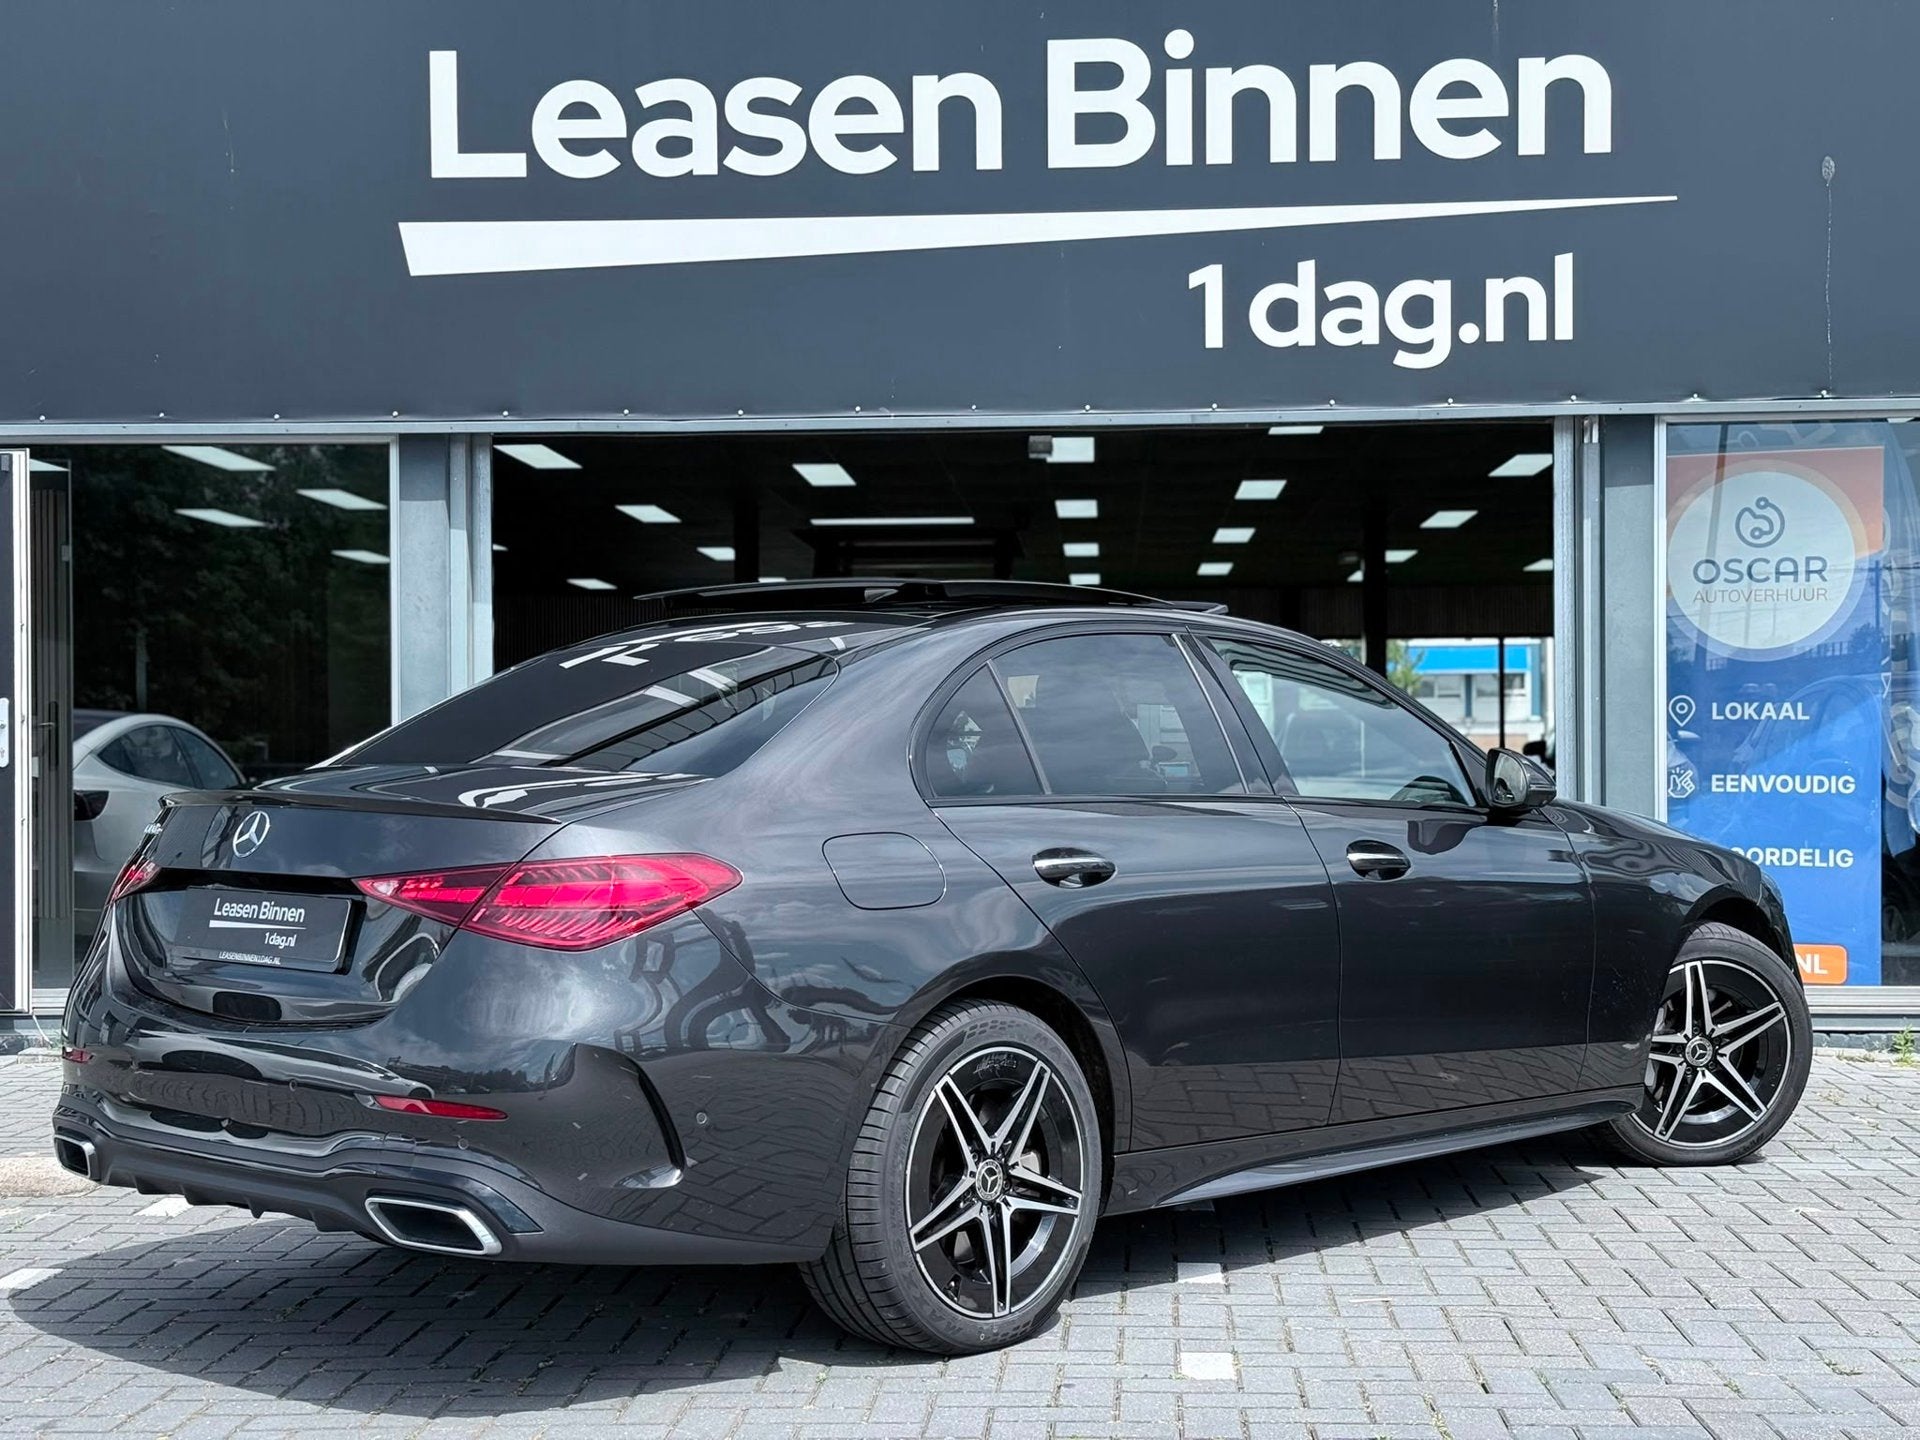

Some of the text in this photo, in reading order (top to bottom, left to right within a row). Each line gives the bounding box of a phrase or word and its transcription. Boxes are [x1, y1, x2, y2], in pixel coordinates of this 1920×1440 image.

[429, 29, 1611, 178] Leasen Binnen
[1693, 556, 1828, 584] OSCAR
[1693, 588, 1828, 603] AUTOVERHUUR
[1712, 702, 1810, 720] LOKAAL
[1712, 775, 1856, 794] EENVOUDIG
[1729, 847, 1854, 868] ORDELIG
[214, 898, 305, 923] Leasen Binnen
[1795, 953, 1828, 974] NL
